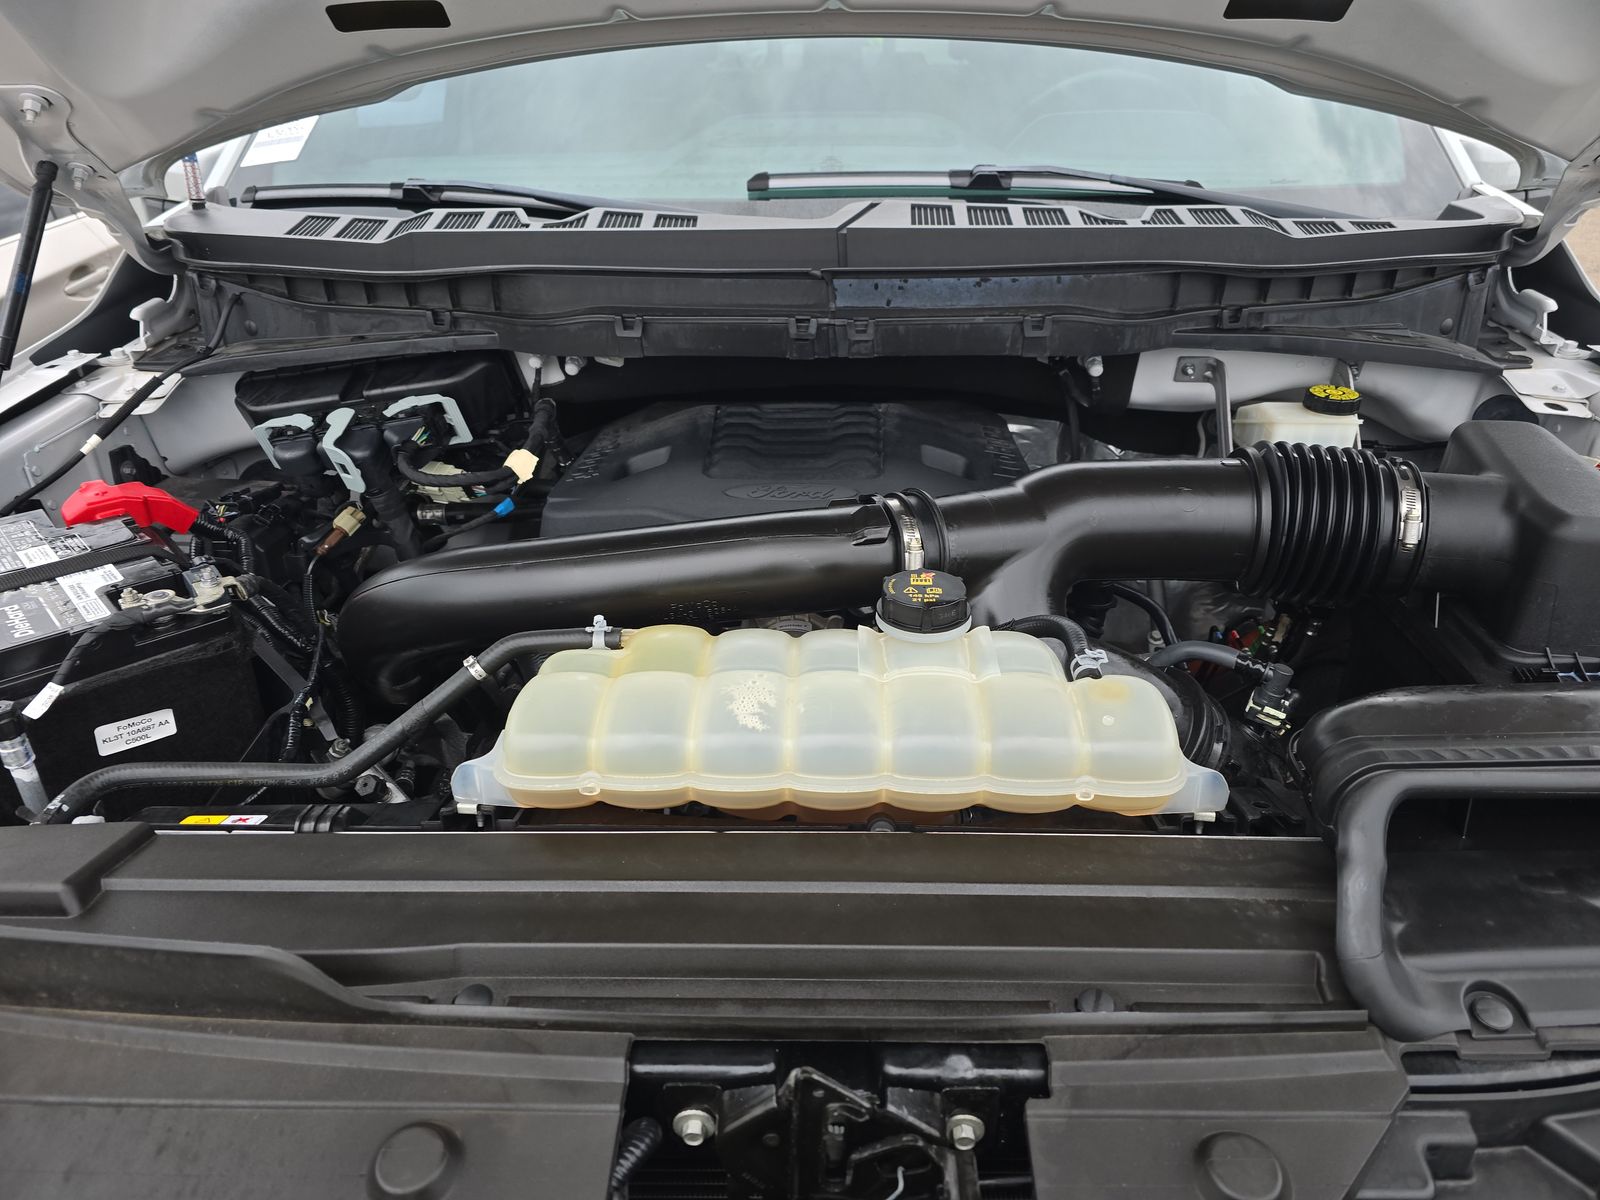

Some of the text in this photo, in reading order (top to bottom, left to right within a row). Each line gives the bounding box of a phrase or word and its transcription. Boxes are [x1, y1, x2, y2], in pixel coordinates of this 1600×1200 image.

[747, 485, 837, 500] Ford
[0, 604, 35, 639] DieHard
[102, 733, 124, 744] KL3T
[158, 719, 170, 728] AA
[117, 718, 152, 732] FoMoCo
